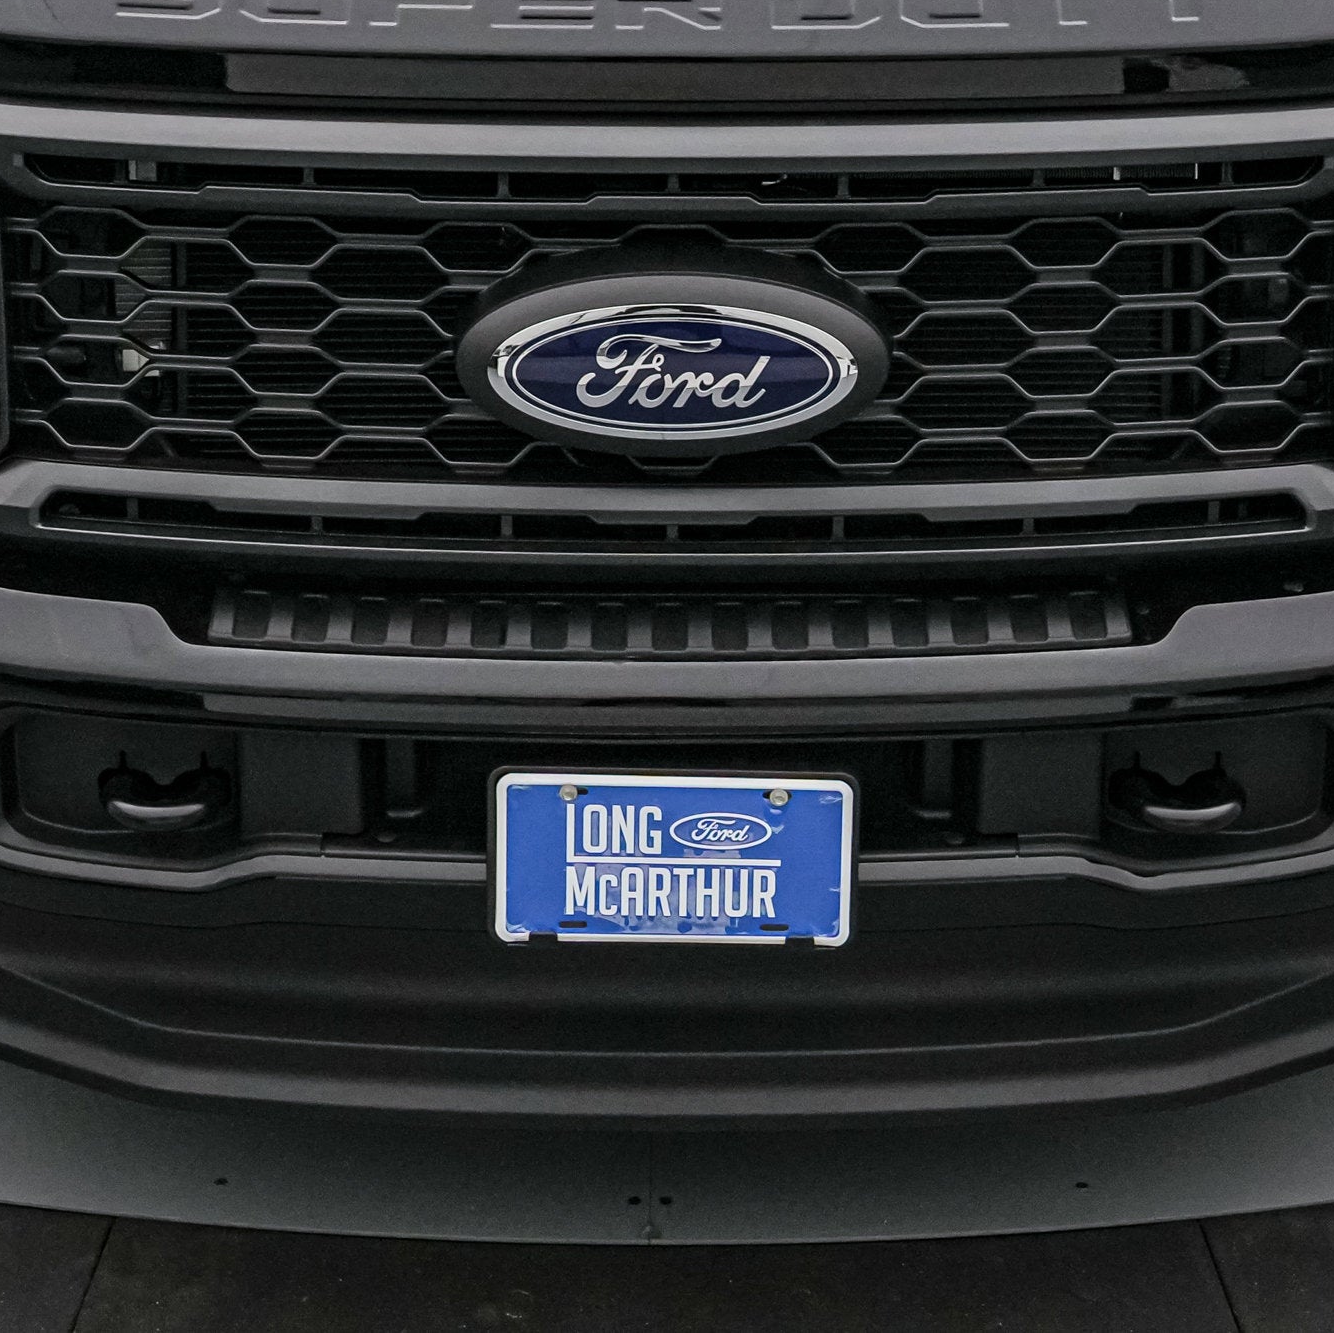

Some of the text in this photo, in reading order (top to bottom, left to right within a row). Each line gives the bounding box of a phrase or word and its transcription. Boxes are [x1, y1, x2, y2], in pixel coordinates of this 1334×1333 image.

[576, 333, 771, 408] Ford
[566, 803, 751, 858] LONG Ford
[565, 865, 777, 919] McARTHUR
